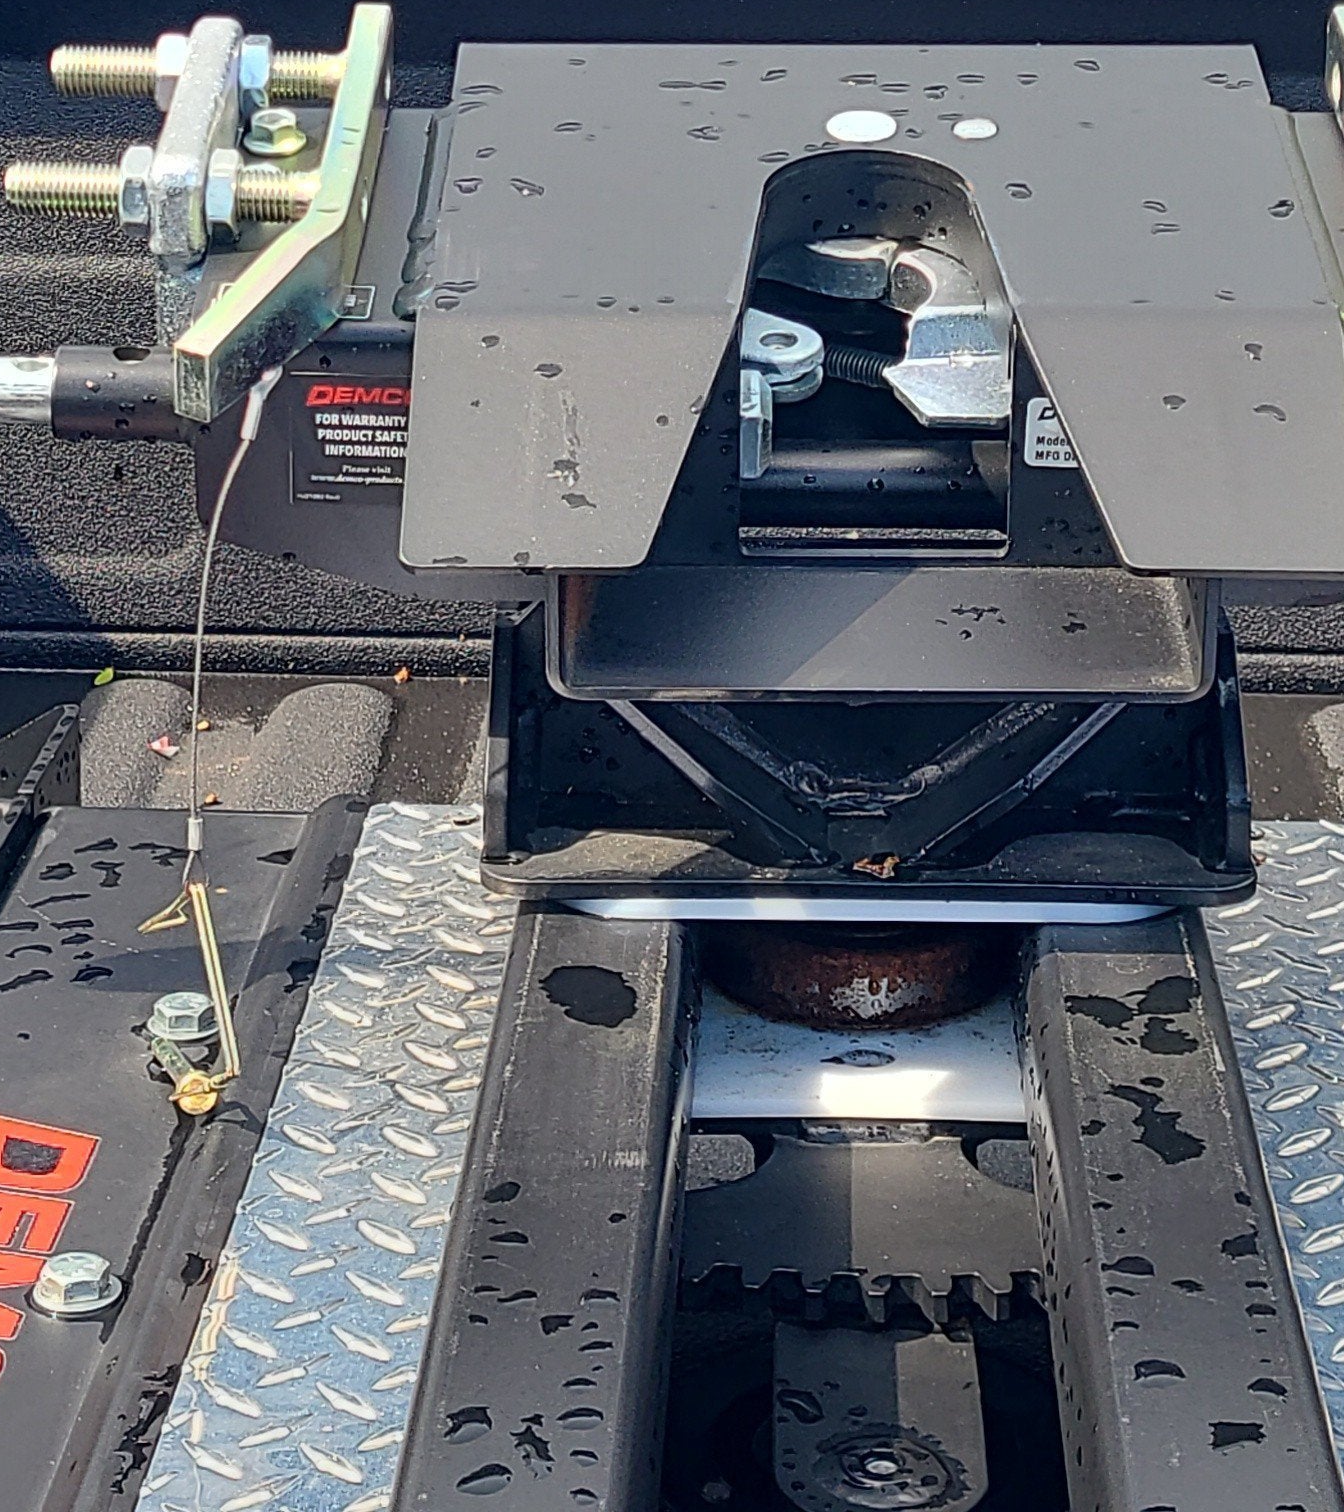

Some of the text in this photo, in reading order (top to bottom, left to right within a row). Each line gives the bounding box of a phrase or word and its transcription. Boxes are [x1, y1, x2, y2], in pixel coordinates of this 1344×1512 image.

[315, 413, 407, 427] FOR WARRANTY
[317, 428, 373, 441] PRODUCT
